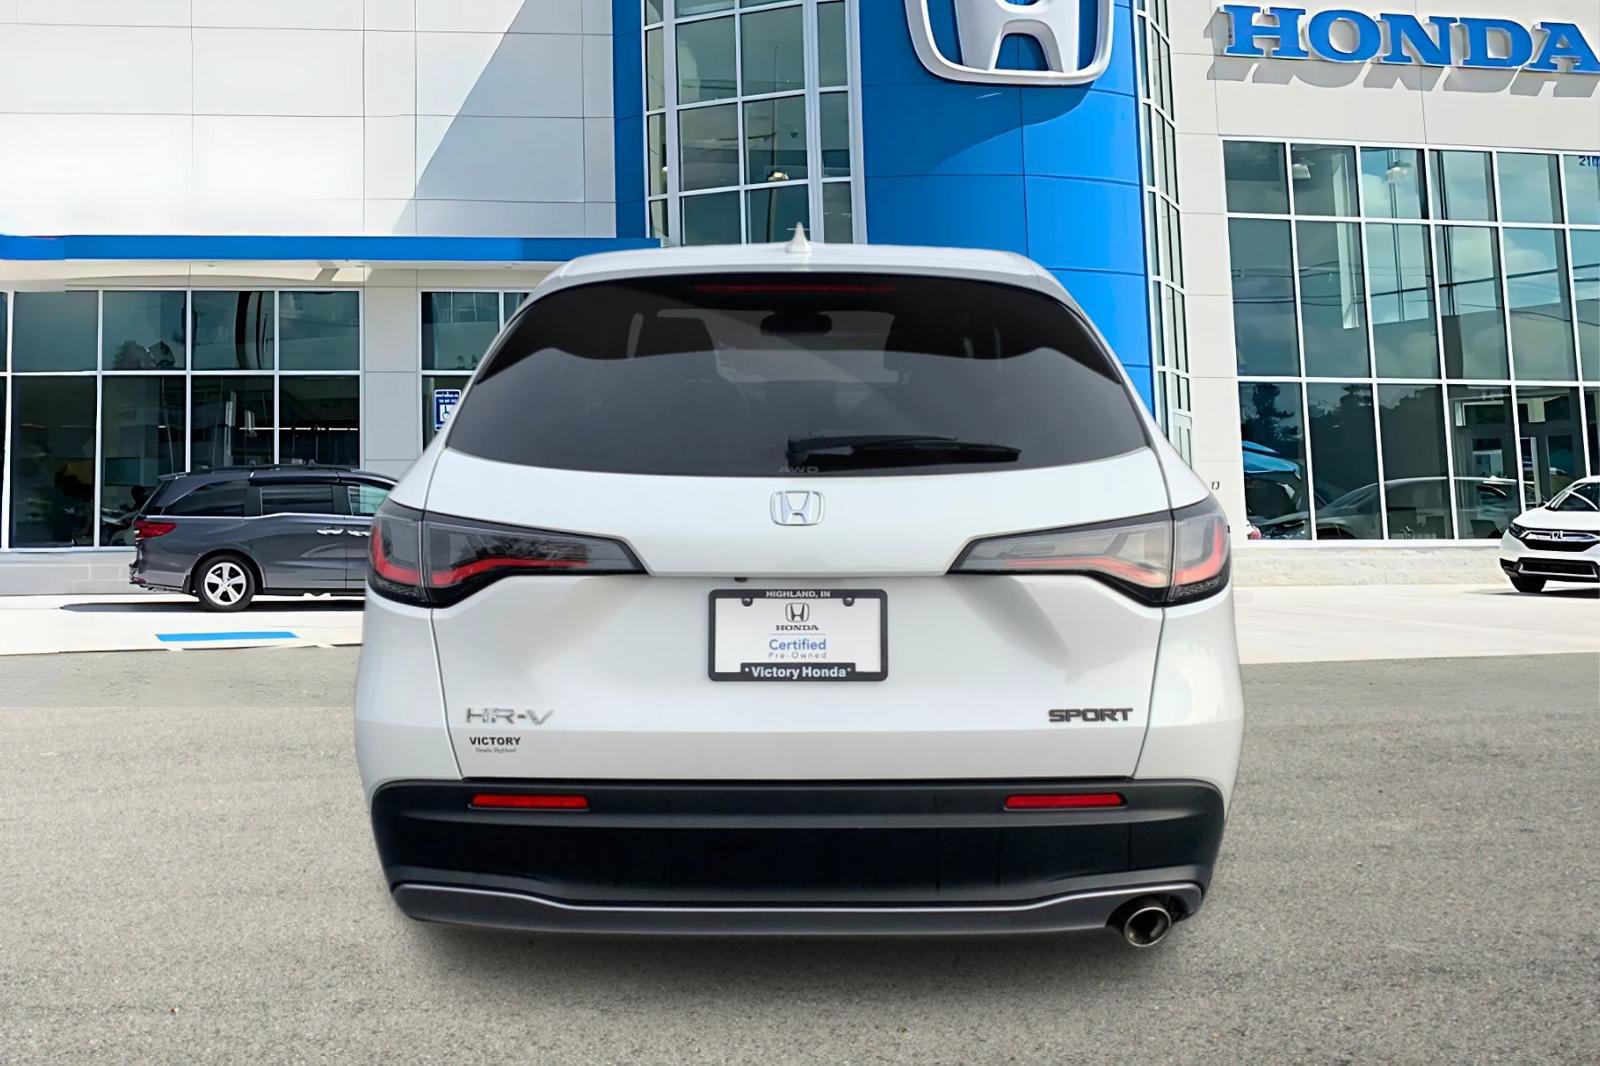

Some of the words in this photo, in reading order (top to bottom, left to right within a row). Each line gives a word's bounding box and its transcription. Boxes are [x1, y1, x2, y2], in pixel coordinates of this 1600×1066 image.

[1223, 4, 1600, 74] HONDA
[777, 466, 819, 474] AWD
[766, 590, 818, 598] HIGHLAND,
[820, 590, 831, 598] IN
[768, 638, 827, 651] Certified
[751, 666, 800, 680] Victory
[802, 666, 847, 678] Honda
[466, 707, 555, 725] HR-V
[1048, 707, 1134, 723] SPORT
[469, 736, 521, 746] VICTORY
